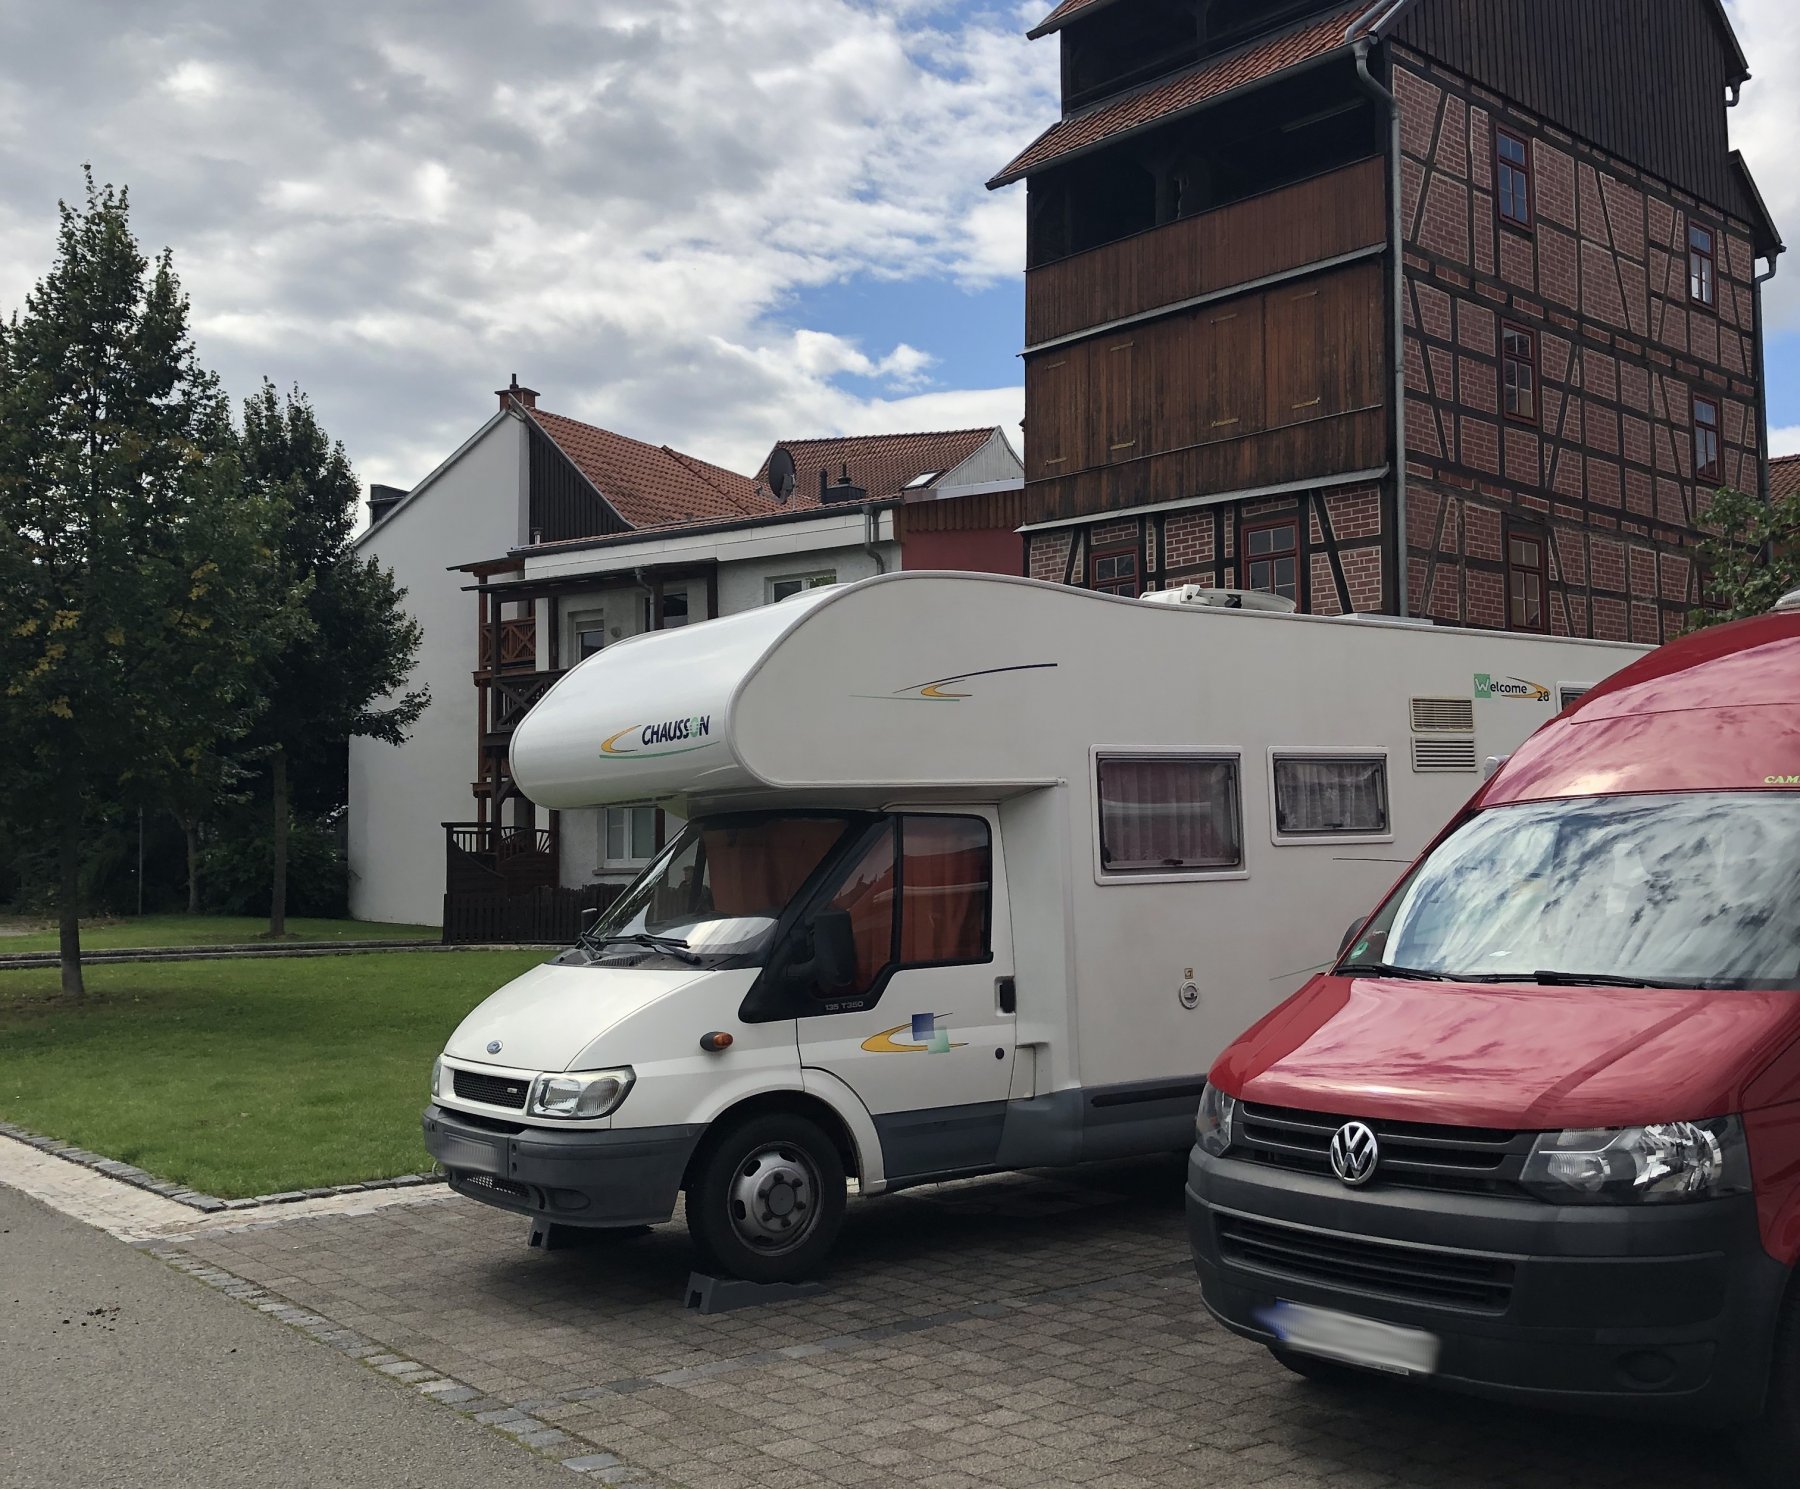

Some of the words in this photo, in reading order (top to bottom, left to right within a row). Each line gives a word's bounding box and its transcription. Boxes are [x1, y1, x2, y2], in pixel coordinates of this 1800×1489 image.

[1474, 678, 1527, 694] Welcome
[1537, 690, 1550, 702] 28
[641, 715, 710, 746] CHAUSSON
[1764, 775, 1800, 784] CAM
[841, 1001, 864, 1009] T350
